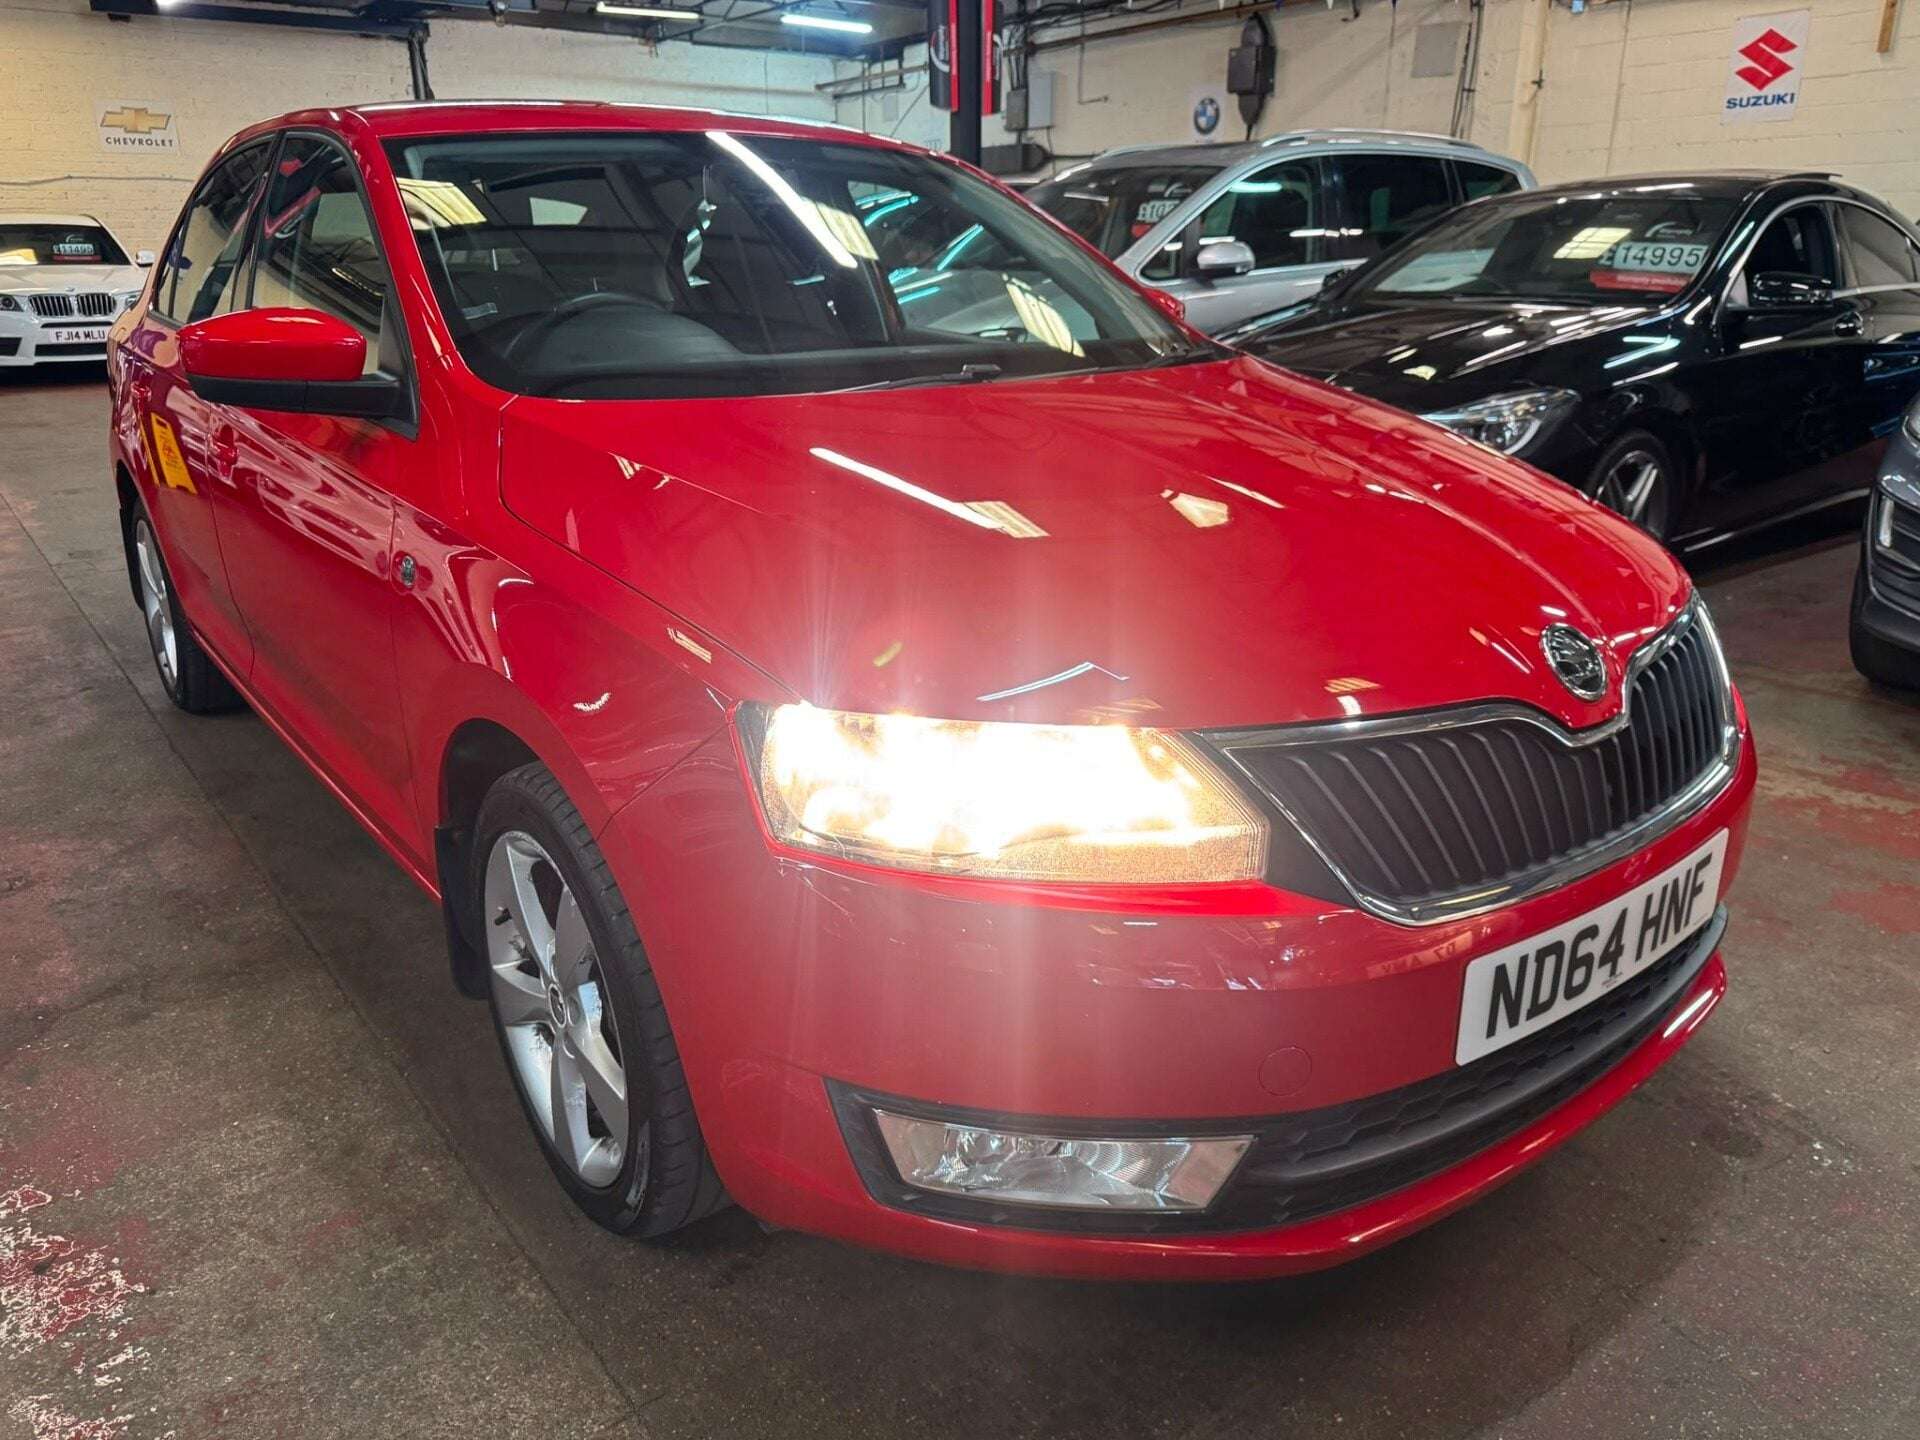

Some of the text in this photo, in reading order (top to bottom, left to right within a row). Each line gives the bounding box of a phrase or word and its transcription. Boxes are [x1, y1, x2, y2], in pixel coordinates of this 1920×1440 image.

[1726, 92, 1796, 110] SUZUKI
[105, 136, 173, 148] CHEVROLET
[1485, 851, 1713, 1040] ND64 HNF
